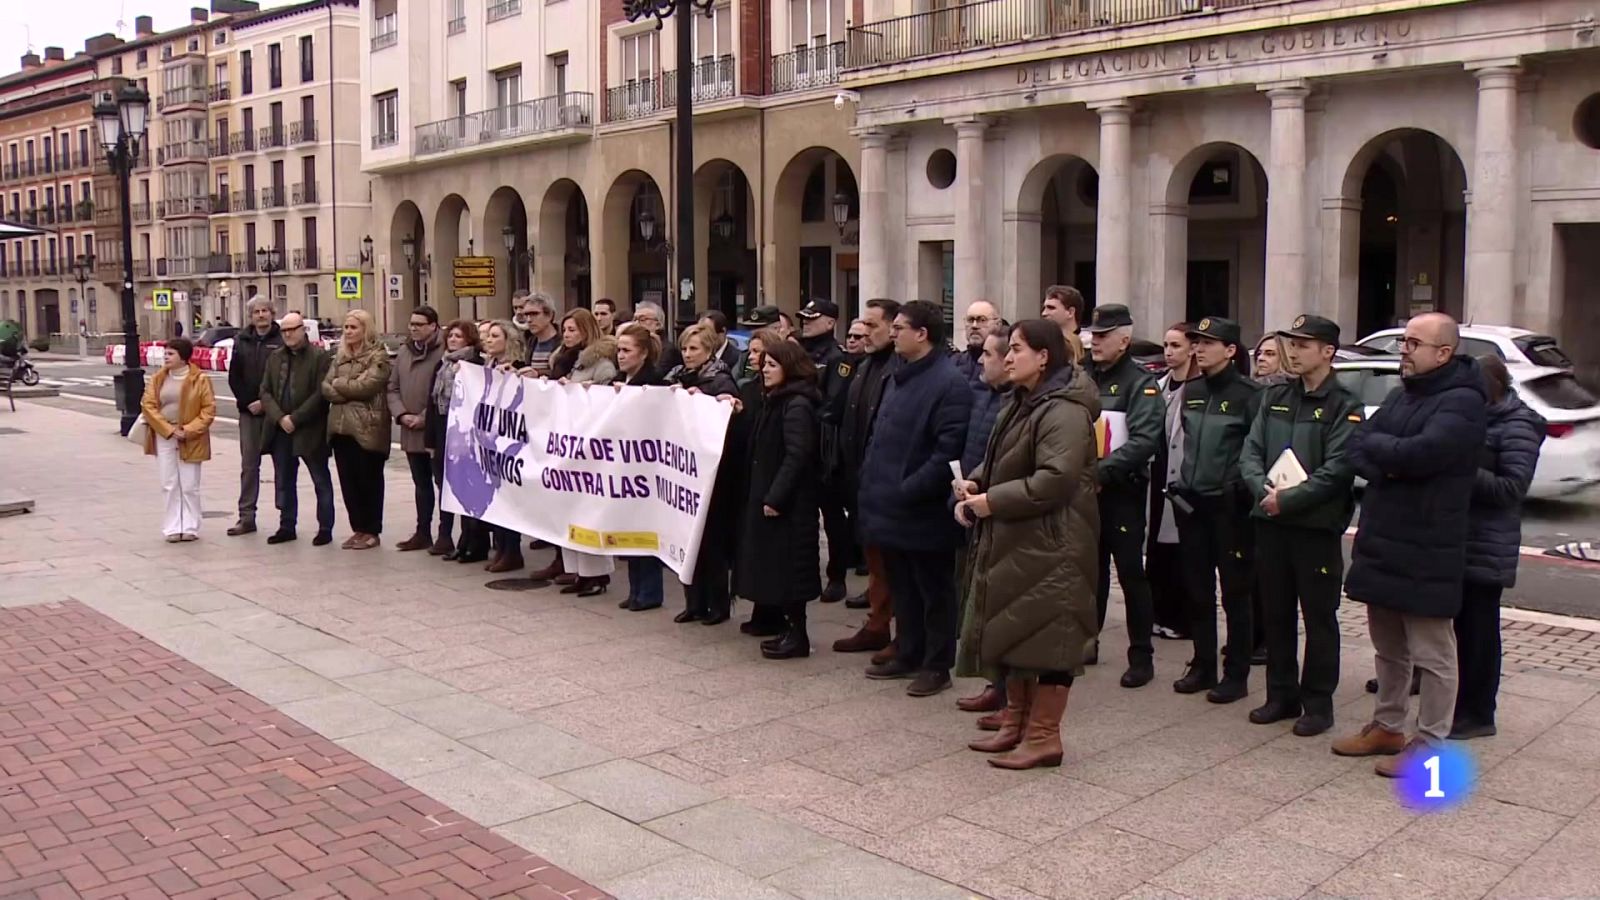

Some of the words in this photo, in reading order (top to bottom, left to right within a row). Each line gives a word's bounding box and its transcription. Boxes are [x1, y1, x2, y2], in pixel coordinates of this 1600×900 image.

[1016, 50, 1168, 85] DELEGACION
[1188, 42, 1239, 63] DEL
[1261, 21, 1412, 54] GOBIERNO
[478, 402, 495, 433] NI
[498, 407, 528, 444] UNA
[479, 445, 524, 487] MENOS
[546, 432, 586, 460] BASTA
[590, 438, 614, 462] DE
[619, 438, 698, 478] VIOLENCIA
[541, 466, 604, 497] CONTRA
[609, 474, 650, 499] LAS
